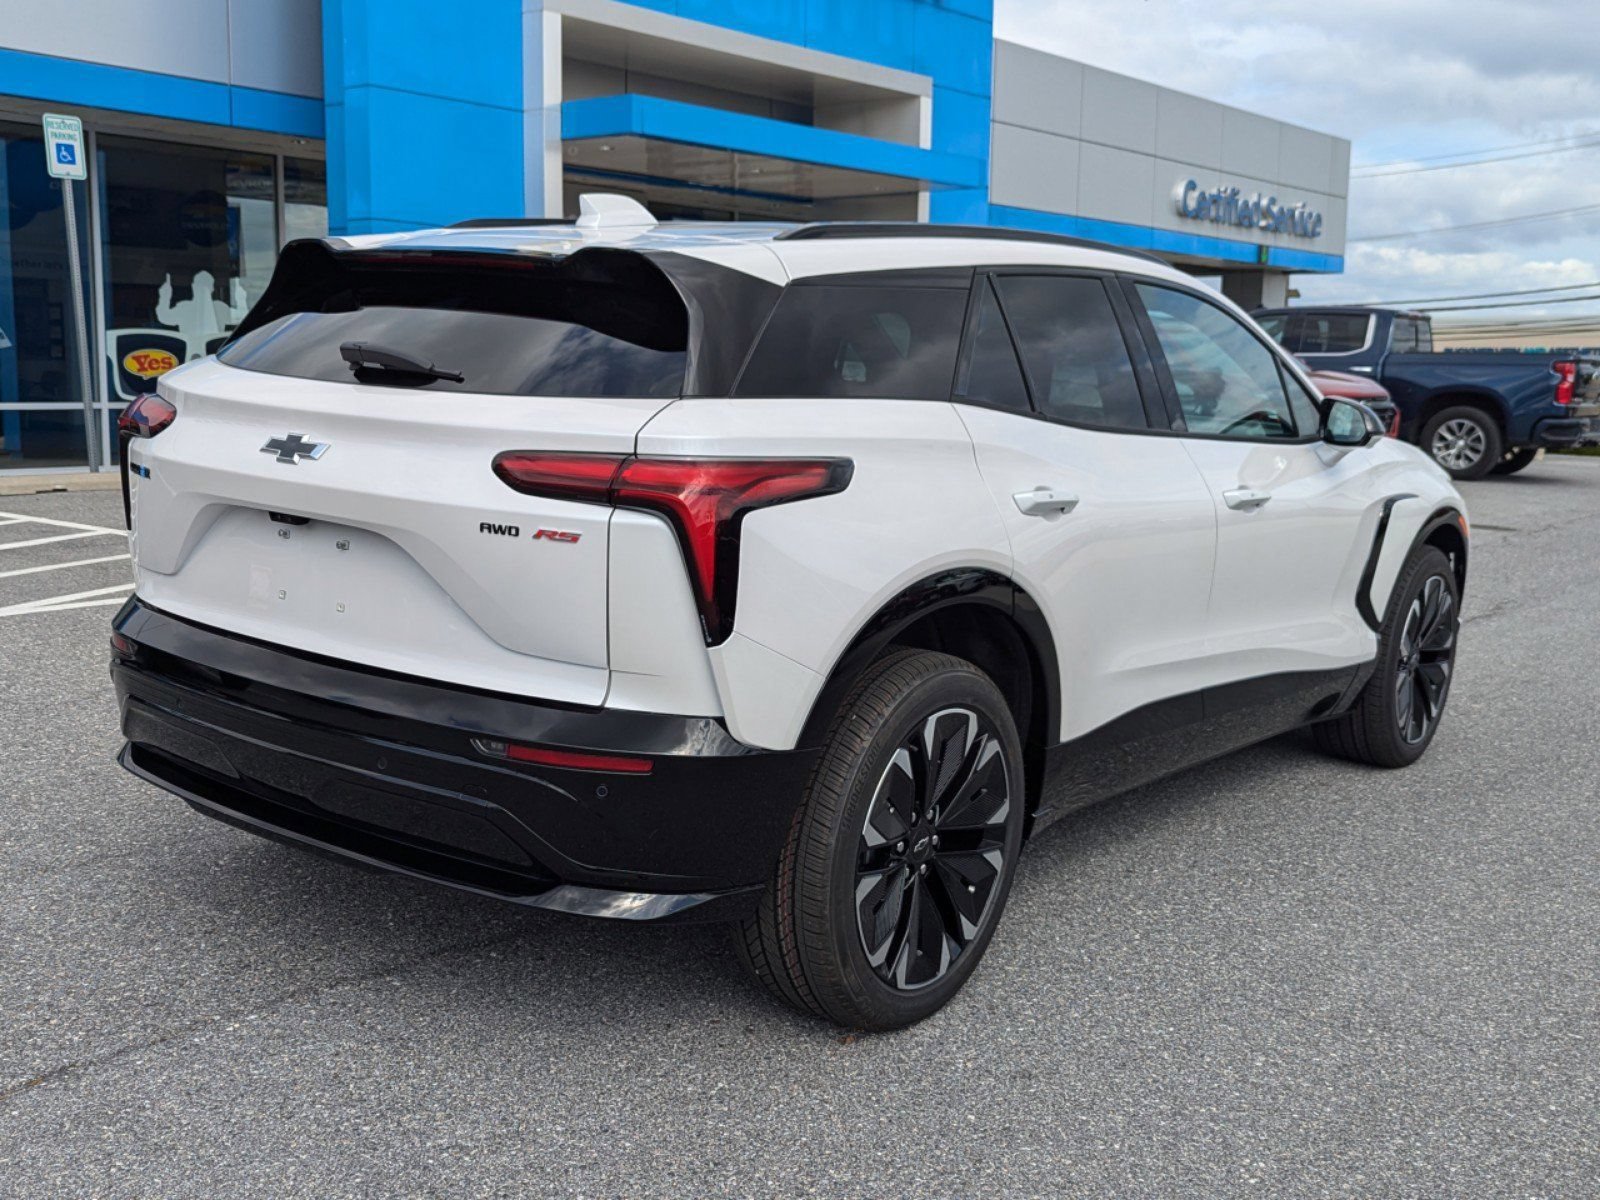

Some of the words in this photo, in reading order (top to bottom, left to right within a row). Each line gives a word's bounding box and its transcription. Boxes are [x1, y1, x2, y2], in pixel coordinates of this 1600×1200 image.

[45, 120, 80, 131] RESERVED
[51, 131, 78, 141] PARKING
[1177, 179, 1261, 228] Certified
[1260, 195, 1322, 238] Service
[132, 355, 174, 372] Yes
[532, 529, 583, 544] RS
